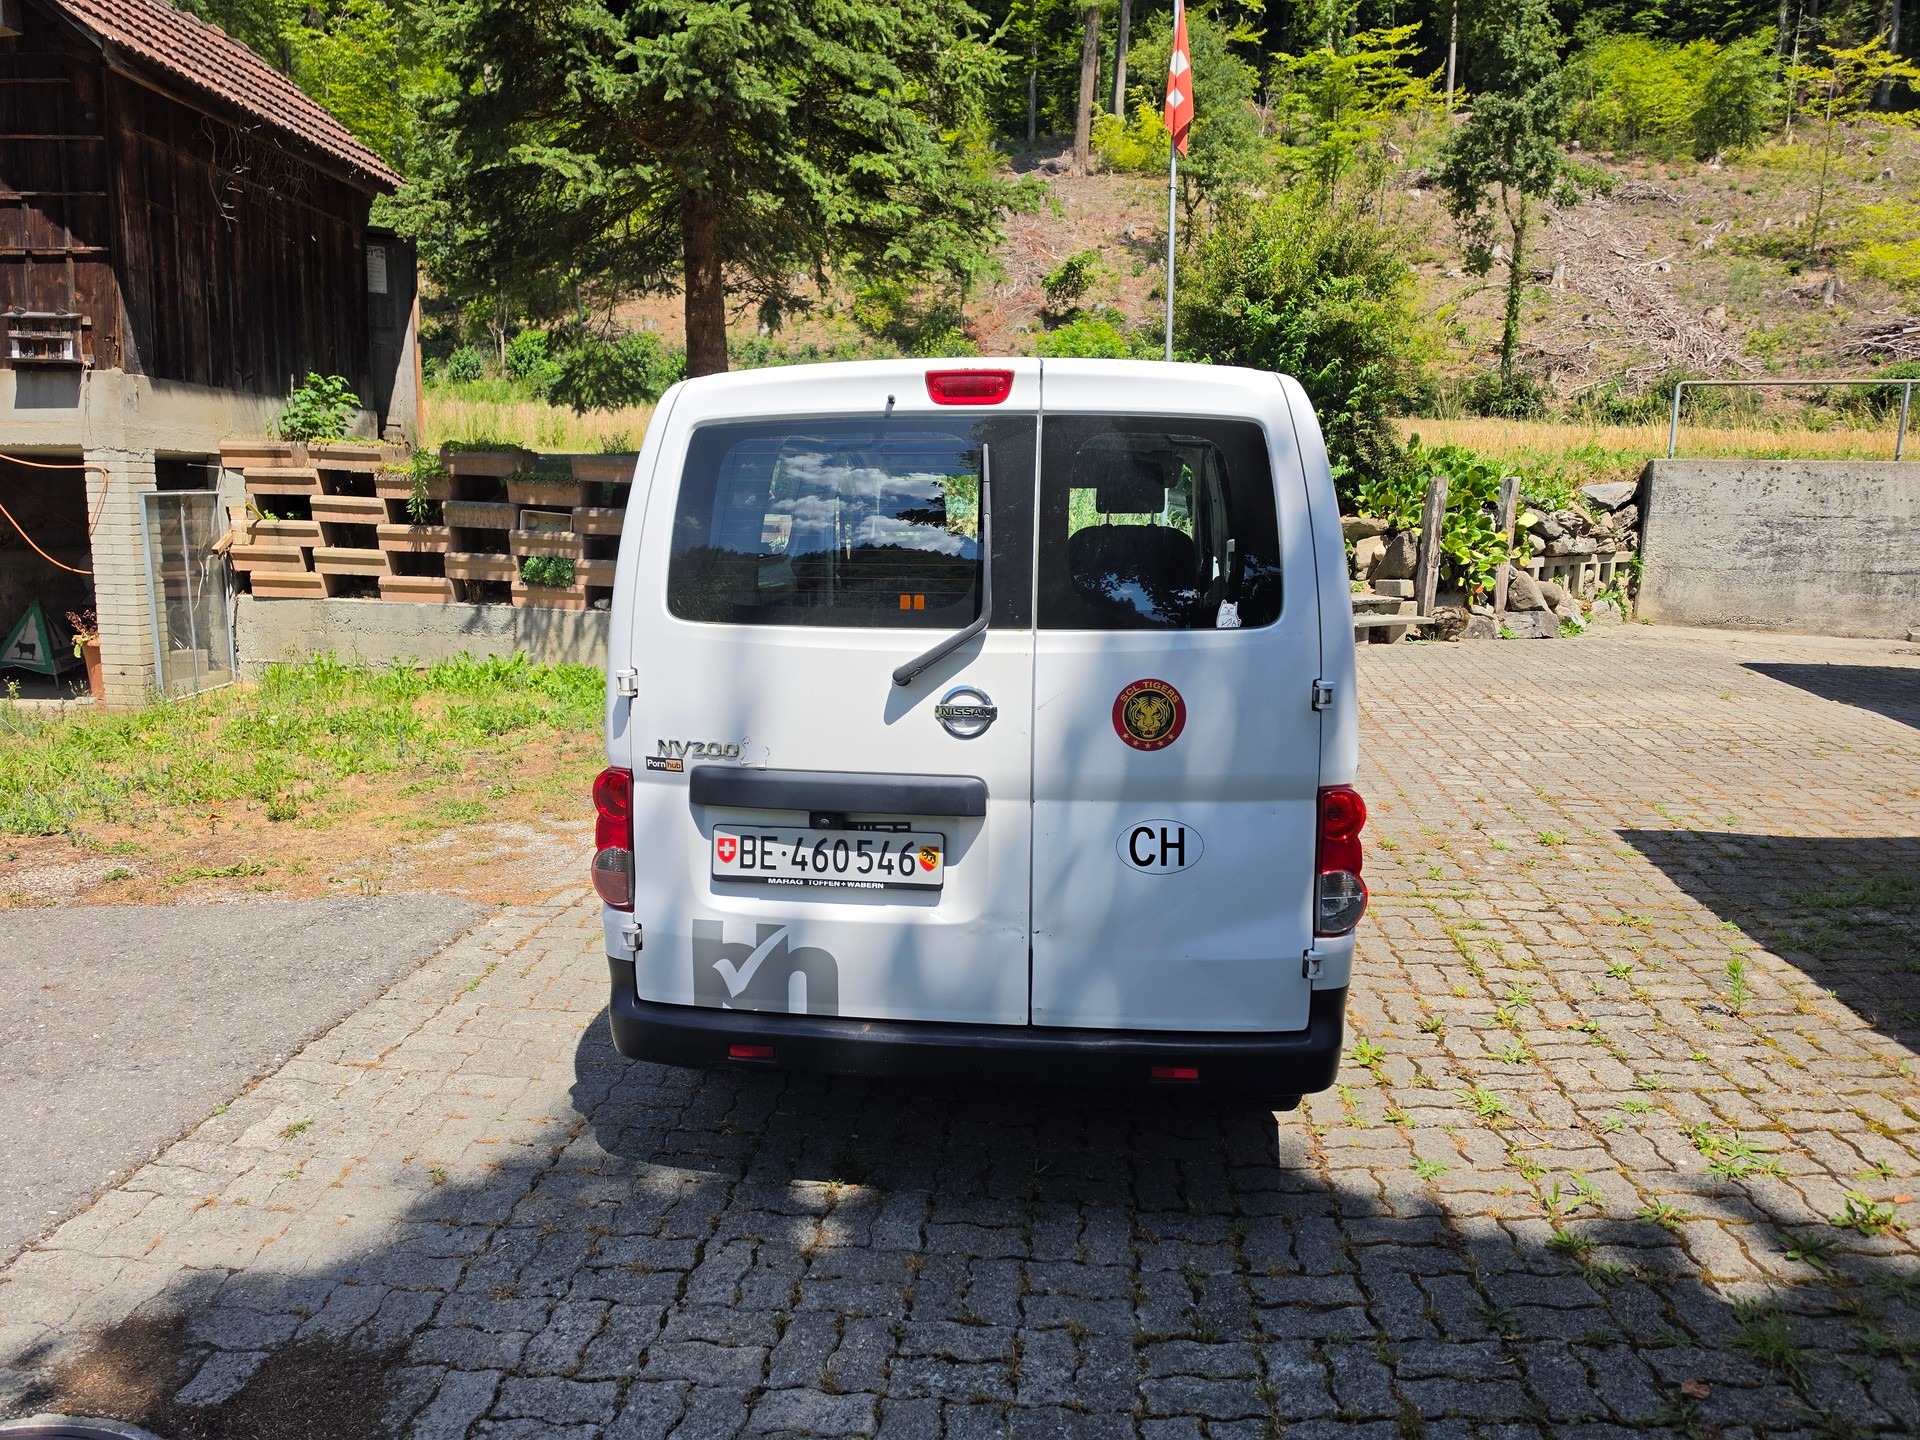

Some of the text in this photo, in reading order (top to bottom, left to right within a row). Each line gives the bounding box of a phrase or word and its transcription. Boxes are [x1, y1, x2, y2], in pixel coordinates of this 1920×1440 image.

[1120, 681, 1180, 703] SCL TIGERS
[941, 707, 991, 718] NISSAN
[657, 739, 740, 758] NV200
[1129, 826, 1185, 867] CH
[768, 877, 803, 885] MARAG
